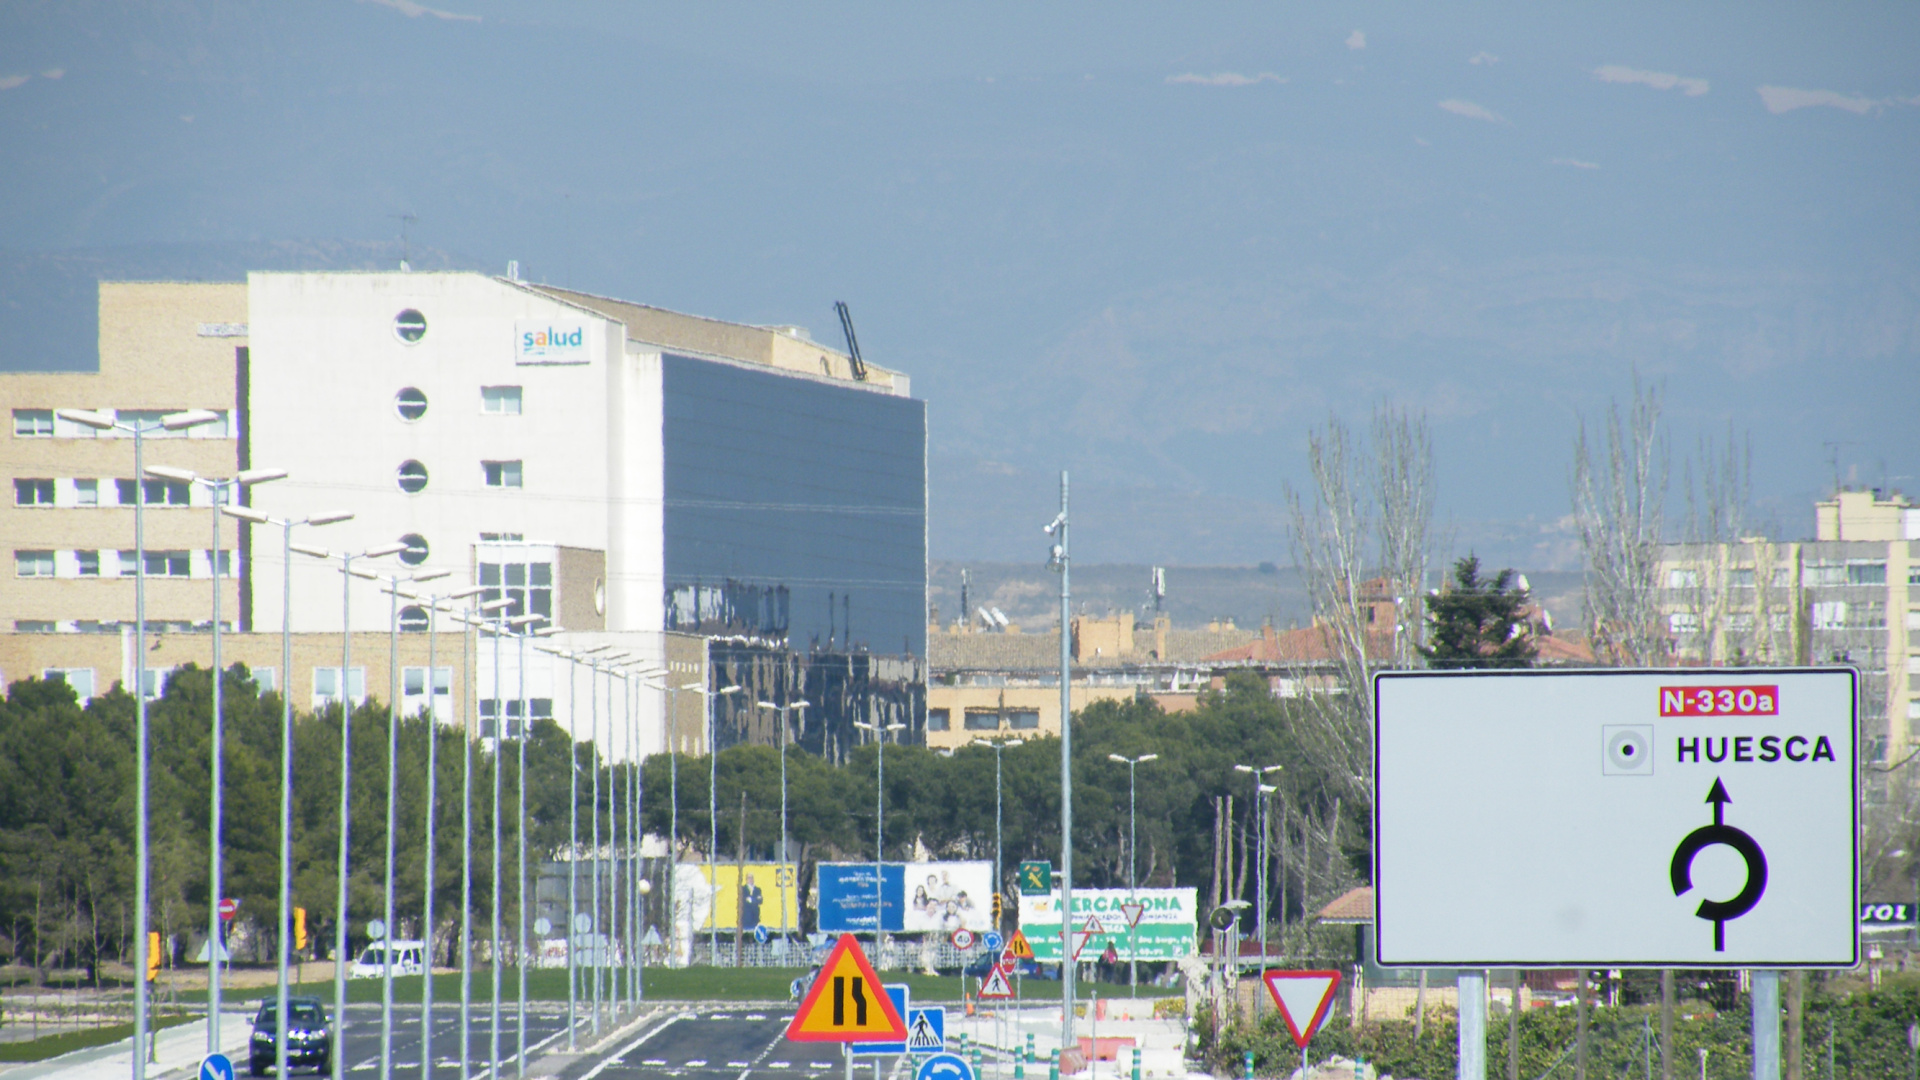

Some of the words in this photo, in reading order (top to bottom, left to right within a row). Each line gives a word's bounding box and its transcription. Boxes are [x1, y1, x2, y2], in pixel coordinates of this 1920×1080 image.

[523, 326, 582, 346] salud
[1663, 689, 1774, 714] N-330a
[1677, 735, 1836, 763] HUESCA
[957, 935, 970, 944] 40
